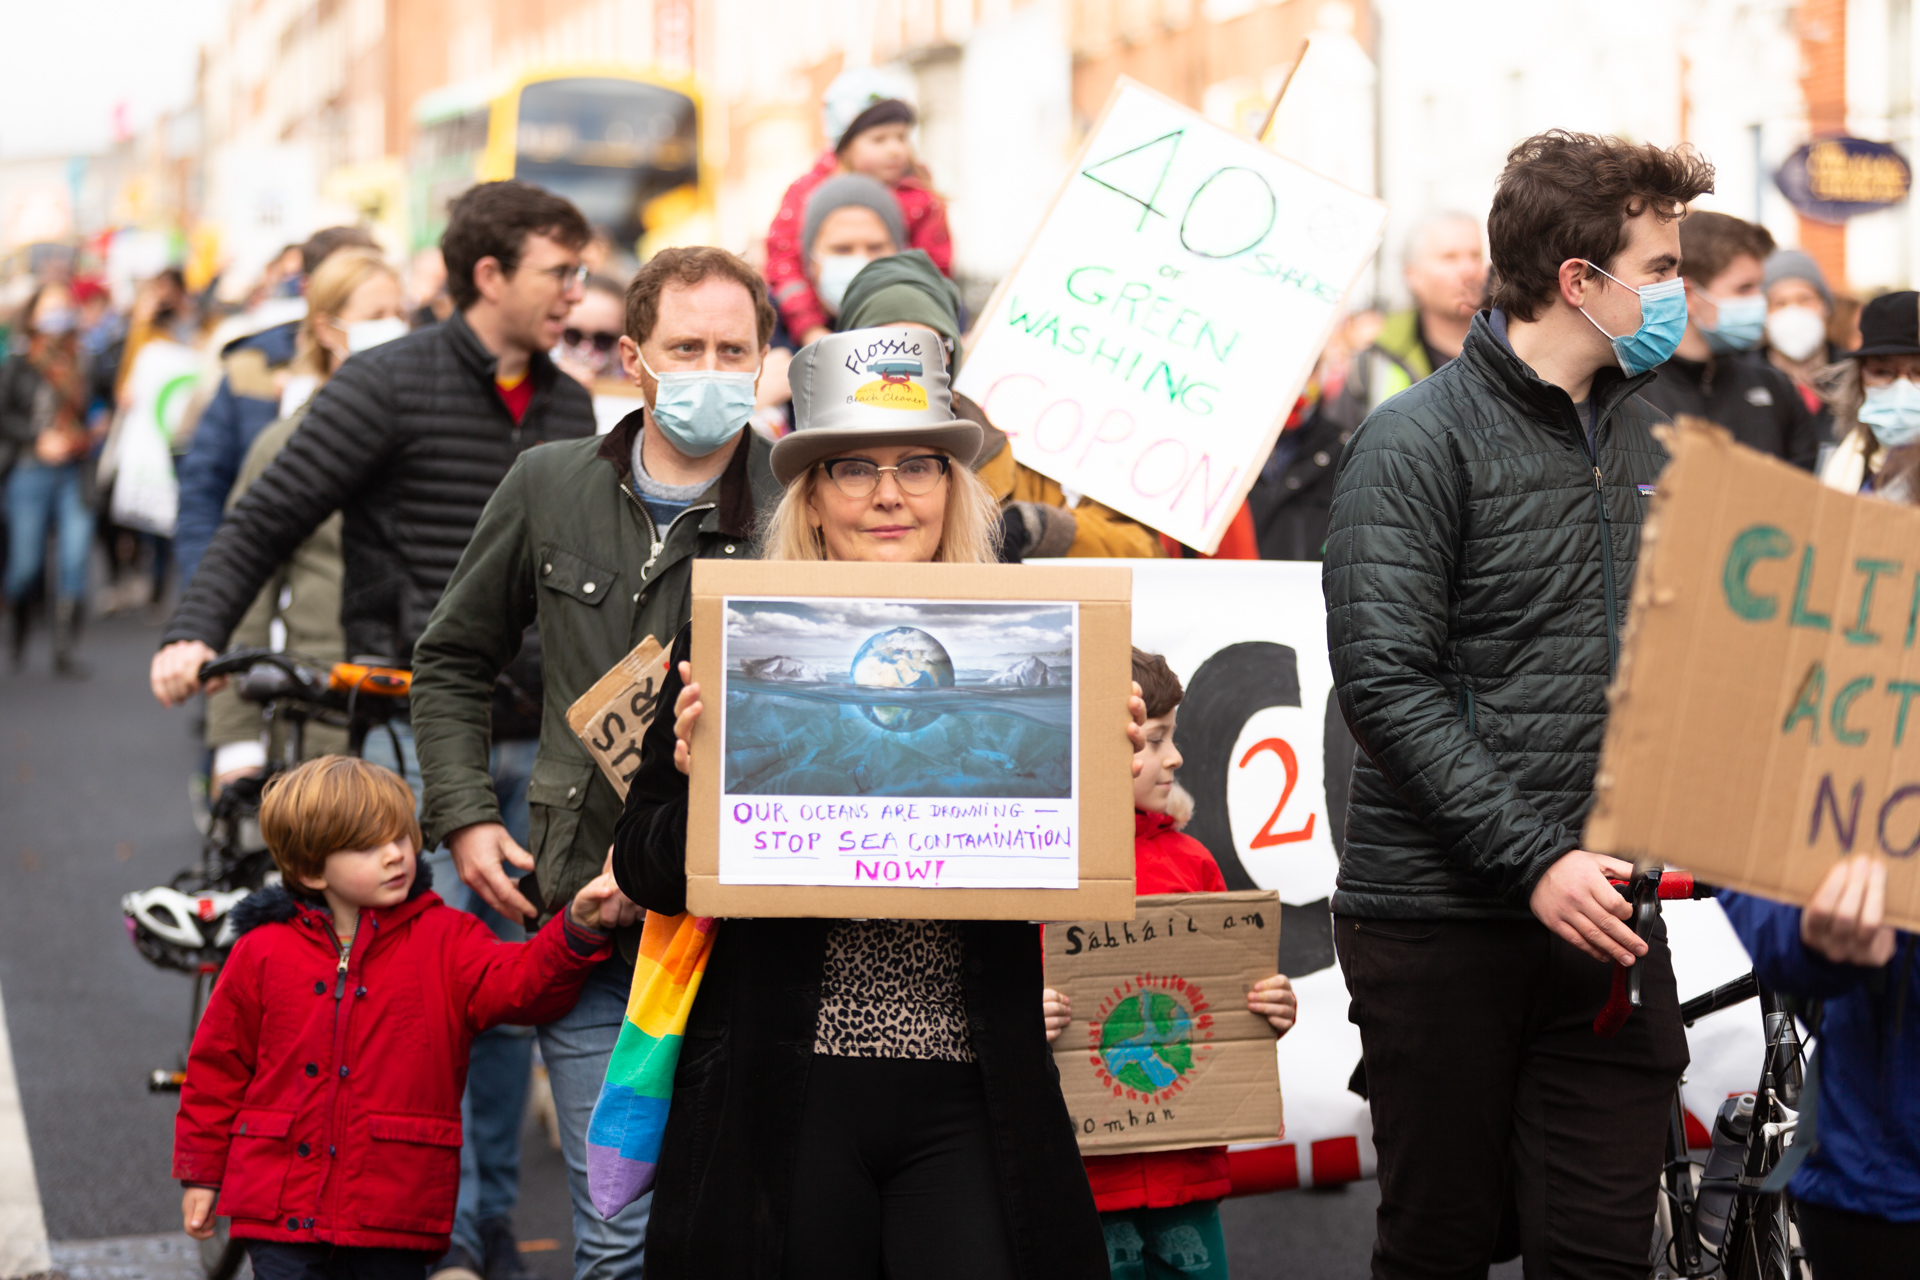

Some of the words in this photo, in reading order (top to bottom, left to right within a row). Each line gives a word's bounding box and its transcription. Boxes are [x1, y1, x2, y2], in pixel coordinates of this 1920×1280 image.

[1081, 130, 1277, 258] 40
[1239, 252, 1344, 304] SHADES
[1158, 264, 1185, 281] OF
[1065, 266, 1239, 364] GREEN
[845, 332, 923, 375] Flossie
[1008, 296, 1221, 416] WASHING
[846, 393, 880, 404] Beach
[883, 393, 927, 407] Cleaners
[1720, 524, 1920, 648] CLI
[733, 802, 789, 824] OUR
[800, 804, 869, 822] OCEANS
[881, 803, 920, 822] ARE
[754, 831, 822, 853] STOP
[838, 830, 898, 852] SEA
[854, 859, 946, 887] NOW!
[1071, 1108, 1176, 1134] omhan
